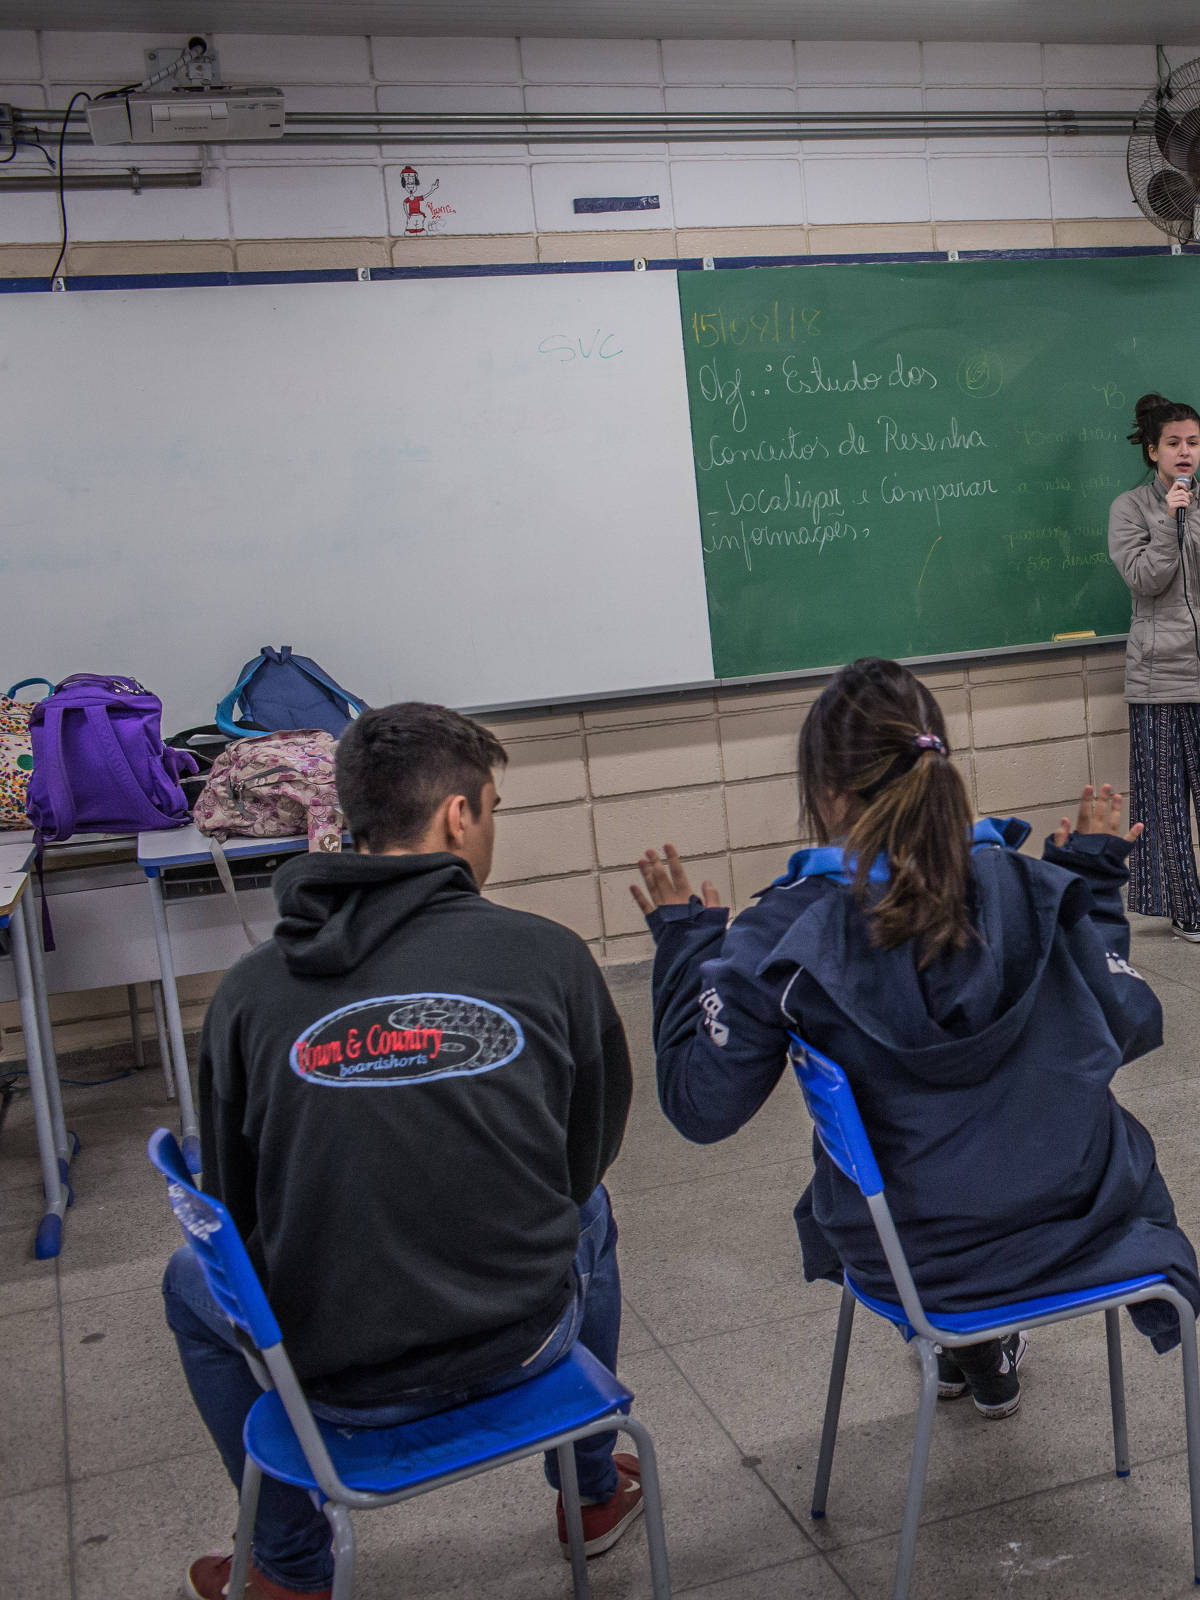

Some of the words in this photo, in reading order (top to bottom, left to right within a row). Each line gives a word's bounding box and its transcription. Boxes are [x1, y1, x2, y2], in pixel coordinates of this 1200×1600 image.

[783, 355, 882, 393] Estudo
[888, 353, 937, 390] dos
[839, 422, 870, 456] de
[295, 1039, 344, 1074] Town
[346, 1029, 362, 1058] &
[366, 1024, 443, 1058] Country
[339, 1053, 428, 1077] boardshorts
